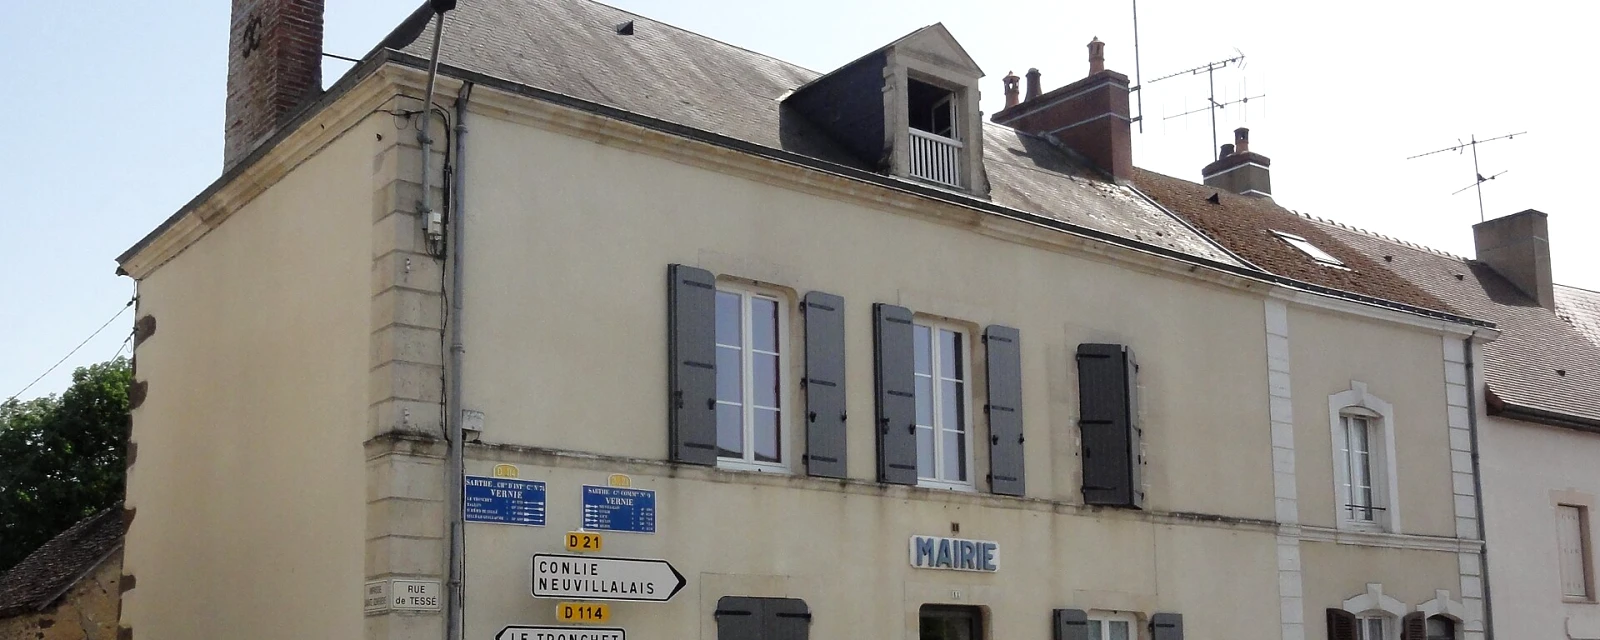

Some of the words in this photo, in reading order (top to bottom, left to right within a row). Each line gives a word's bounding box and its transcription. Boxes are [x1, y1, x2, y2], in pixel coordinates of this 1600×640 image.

[466, 479, 493, 488] SARTHE
[491, 489, 523, 499] VERNIE
[605, 497, 634, 506] VERNIE
[570, 535, 578, 548] D
[583, 536, 599, 549] 21
[916, 536, 997, 571] MAIRIE
[539, 561, 598, 576] CONLIE
[408, 585, 426, 594] RUE
[539, 578, 654, 595] NEUVILLALAIS
[395, 597, 406, 605] de
[410, 596, 437, 606] TESSÉ
[565, 606, 573, 619] D
[578, 607, 603, 620] 114
